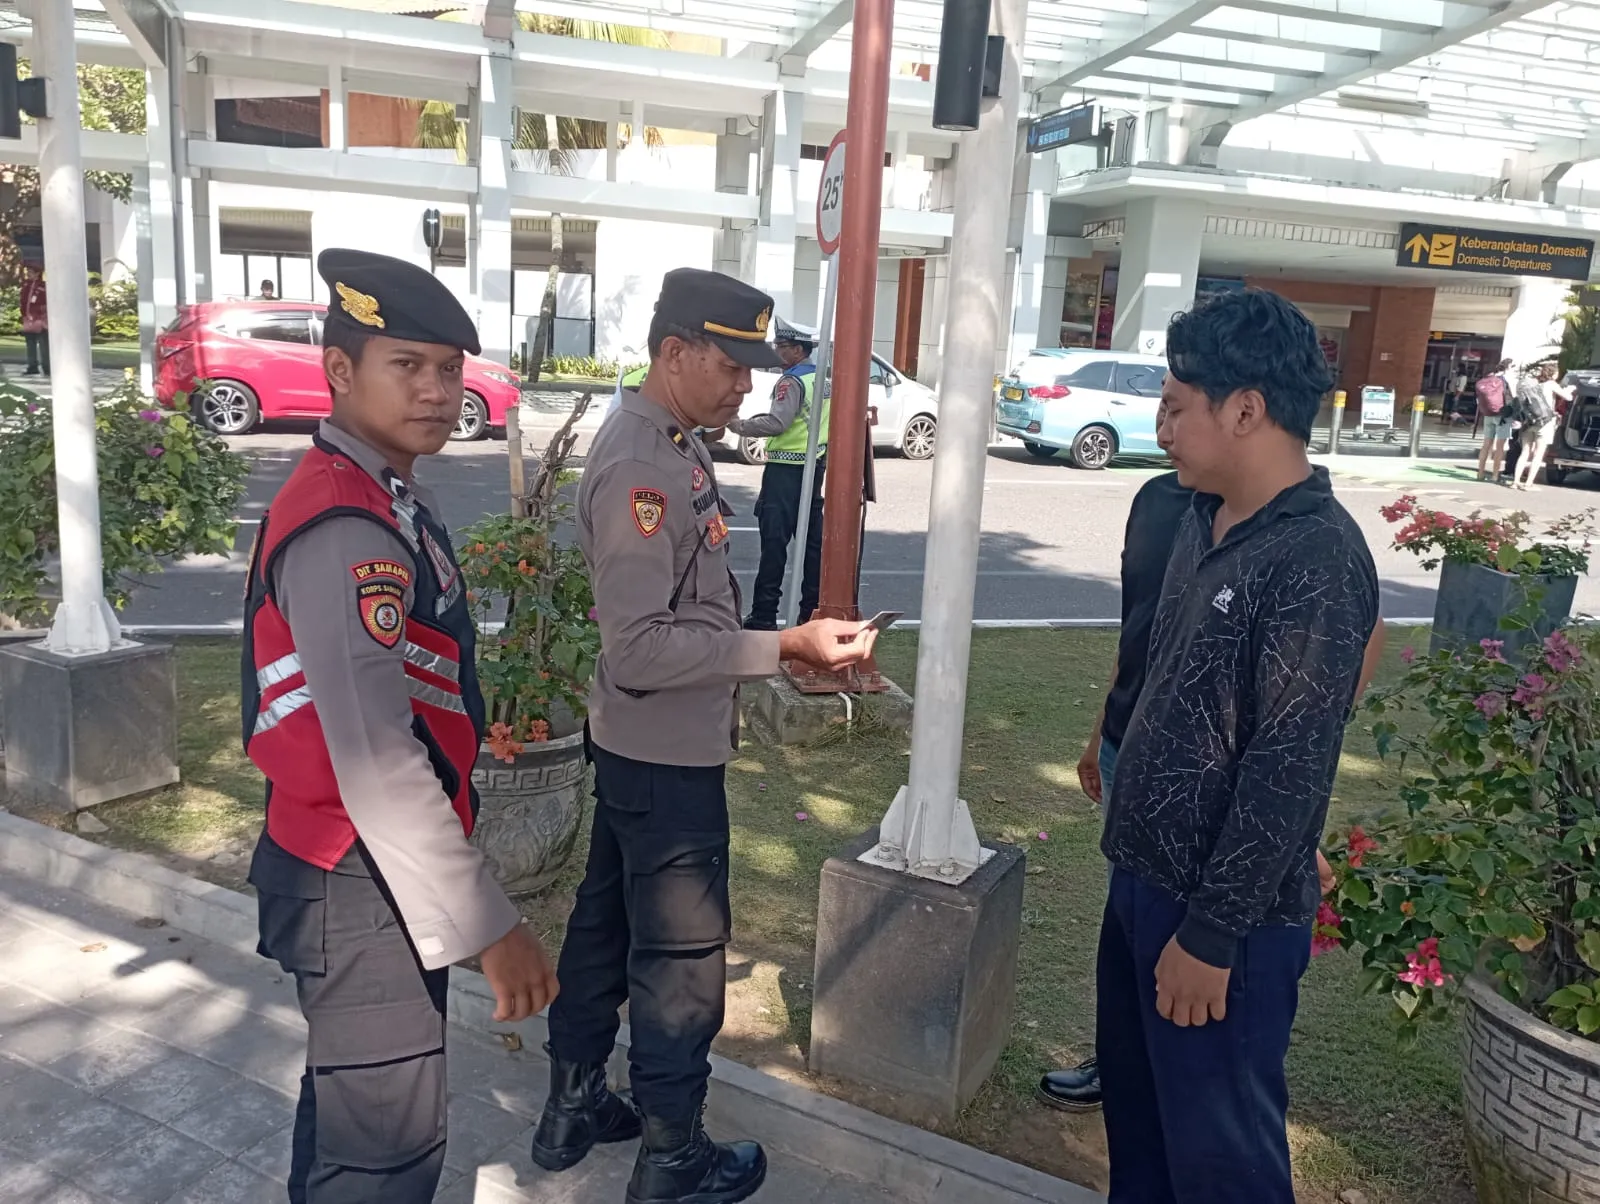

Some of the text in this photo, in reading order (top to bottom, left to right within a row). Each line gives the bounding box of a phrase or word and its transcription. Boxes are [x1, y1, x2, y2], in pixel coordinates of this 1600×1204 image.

[1459, 236, 1588, 258] Keberangkatan Domestik
[1457, 253, 1552, 271] Domestic Departures
[356, 565, 371, 578] DIT
